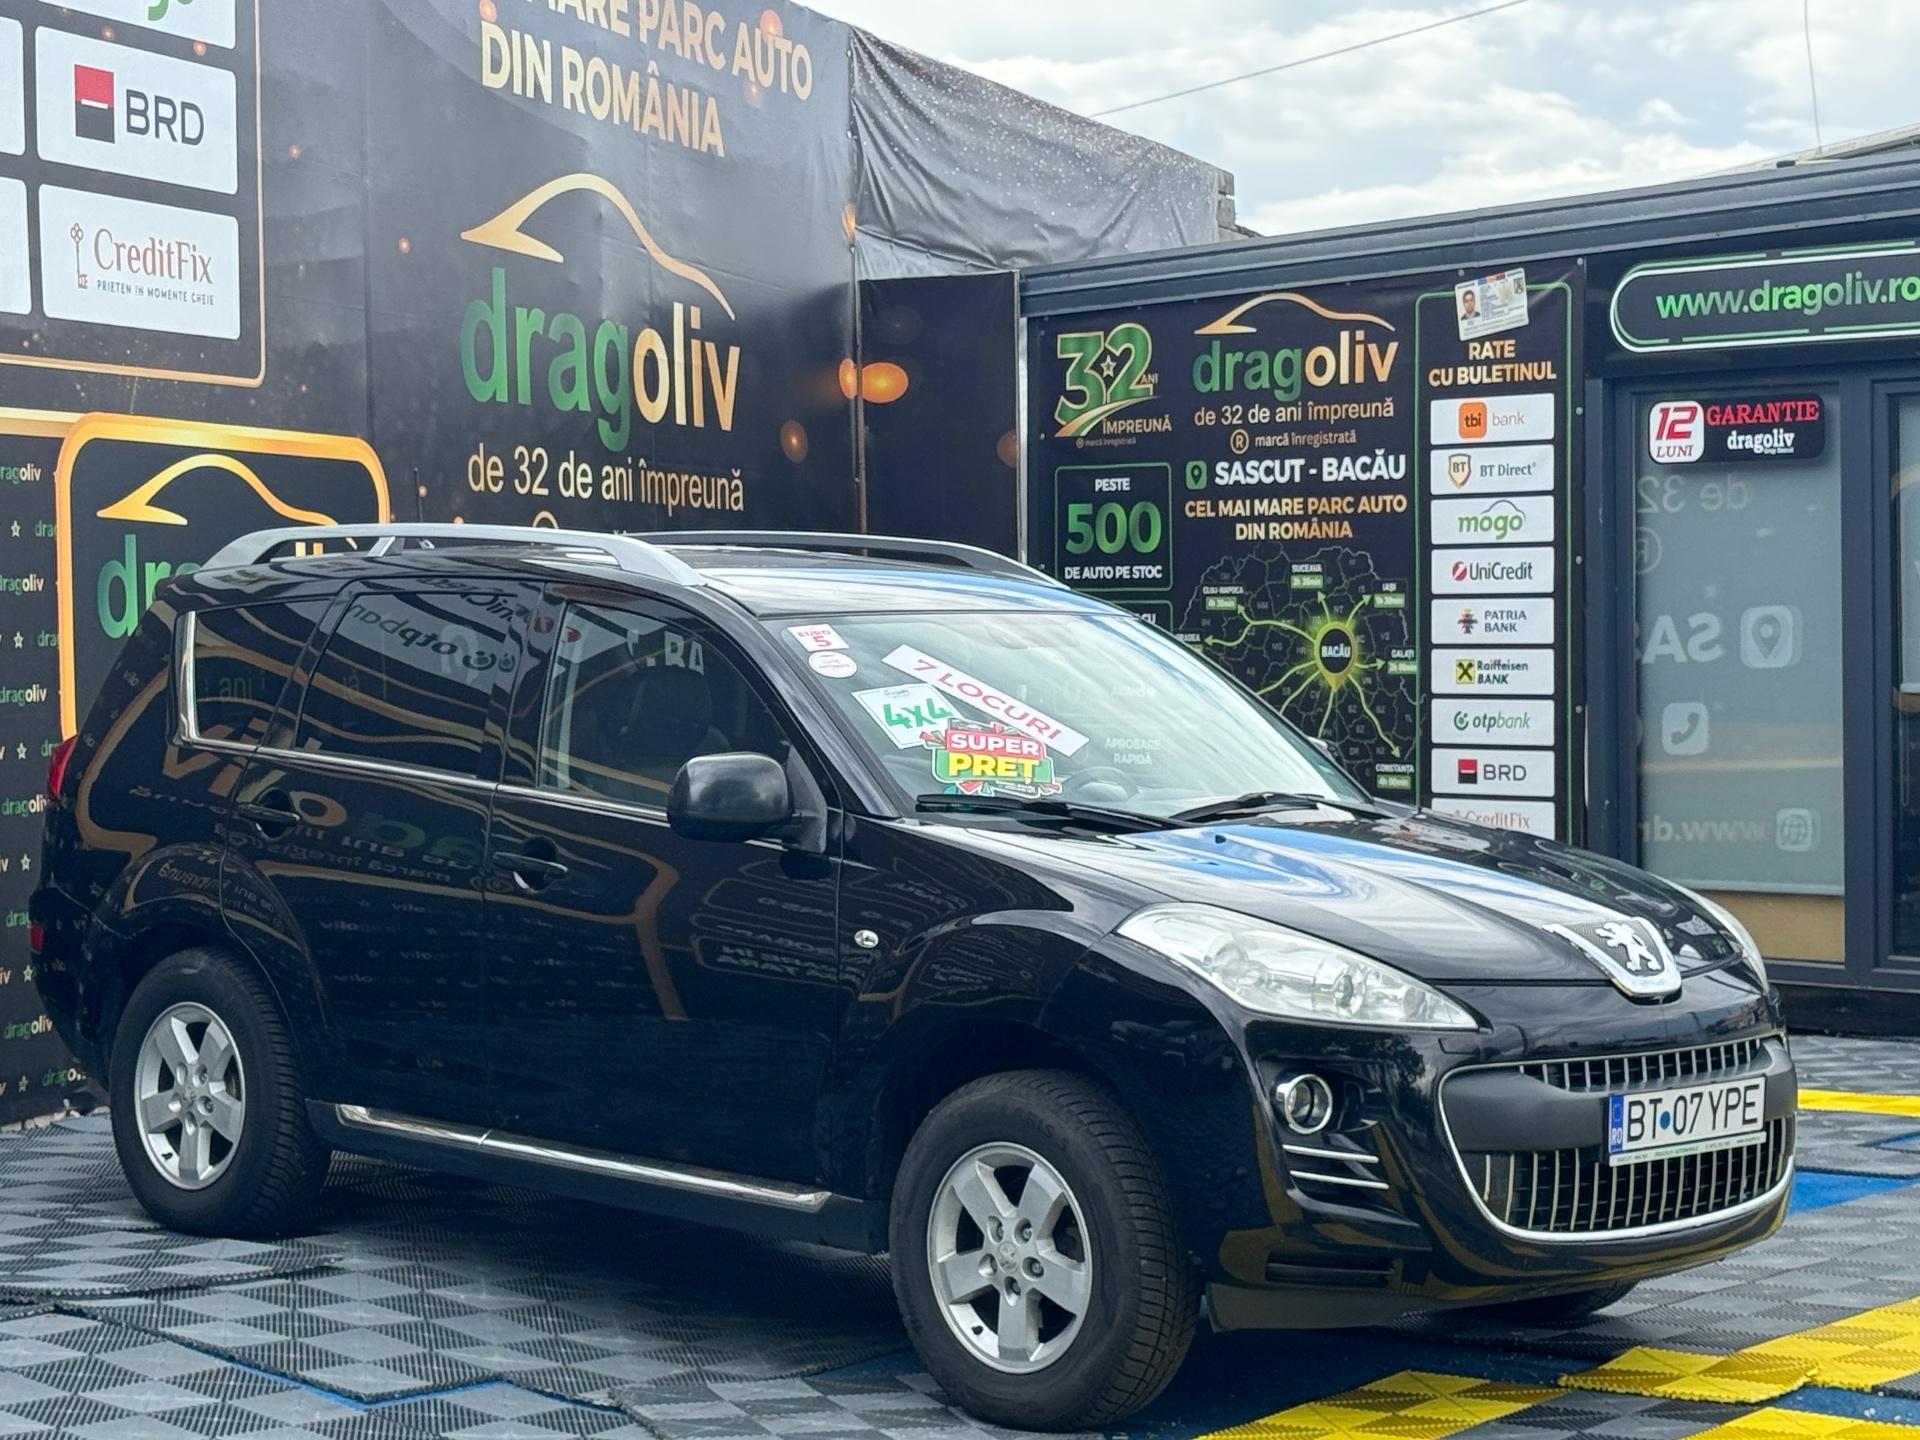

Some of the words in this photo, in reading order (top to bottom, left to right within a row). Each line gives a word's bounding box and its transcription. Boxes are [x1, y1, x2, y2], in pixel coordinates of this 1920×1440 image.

[548, 0, 631, 37] RE
[639, 0, 726, 70] PARC
[731, 21, 813, 100] AUTO
[481, 20, 552, 104] DIN
[562, 46, 725, 158] ROMÂNIA
[126, 89, 205, 146] BRD
[94, 228, 213, 285] CreditFix
[97, 279, 131, 295] PRIETEN
[147, 287, 188, 303] MOMENTE
[191, 292, 214, 306] CHEIE
[1656, 271, 1920, 319] www.dragoliv.ro
[461, 267, 740, 452] dragoliv
[1468, 340, 1516, 360] RATE
[1054, 323, 1152, 426] 32
[1193, 330, 1399, 401] dragoliv
[1428, 368, 1453, 387] CU
[1457, 361, 1556, 385] BULETINUL
[1140, 373, 1159, 385] ANI
[1194, 407, 1216, 426] de
[1221, 404, 1243, 425] 32
[1248, 404, 1270, 424] de
[1275, 402, 1302, 422] ani
[1307, 397, 1394, 424] împreună
[1464, 412, 1482, 428] tbi
[1492, 412, 1525, 427] bank
[1656, 406, 1698, 440] 12
[1706, 401, 1819, 426] GARANTIE
[1102, 414, 1172, 435] ÎMPREUNĂ
[1255, 432, 1289, 447] marcă
[1291, 429, 1356, 448] înregistrată
[1727, 428, 1795, 453] dragoliv
[1656, 445, 1694, 458] LUNI
[0, 463, 41, 484] ragoliv
[1215, 458, 1305, 485] SASCUT
[1322, 448, 1406, 483] BACĂU
[1452, 461, 1466, 474] BT
[1480, 465, 1495, 478] BT
[467, 443, 504, 493] de
[514, 445, 549, 495] 32
[558, 450, 593, 499] de
[601, 457, 633, 502] ani
[639, 458, 744, 517] împreună
[1094, 478, 1130, 492] PESTE
[1185, 500, 1215, 518] CEL
[1218, 499, 1250, 517] MAI
[1254, 497, 1304, 516] MARE
[1308, 496, 1354, 515] PARC
[1357, 494, 1408, 514] AUTO
[1065, 501, 1162, 554] 500
[1235, 523, 1266, 541] DIN
[1269, 518, 1353, 540] ROMÂNIA
[1458, 514, 1523, 540] mogo
[1064, 567, 1081, 580] DE
[1083, 567, 1114, 579] AUTO
[1115, 566, 1132, 579] PE
[1133, 565, 1162, 579] STOC
[1469, 562, 1533, 581] UniCredit
[1484, 610, 1527, 621] PATRIA
[1484, 622, 1517, 633] BANK
[813, 635, 832, 647] 5
[1321, 643, 1351, 658] BACĂU
[1477, 659, 1528, 672] Raiffeisen
[1477, 673, 1509, 685] BANK
[914, 659, 937, 671] 7
[938, 673, 1062, 740] LOCURI
[1472, 712, 1530, 733] otpbank
[951, 733, 1039, 756] SUPER
[949, 752, 1040, 785] PREȚ
[1483, 764, 1527, 781] BRD
[3, 1014, 53, 1039] dragoliv
[1627, 1098, 1663, 1142] BT
[1673, 1092, 1703, 1136] 07
[1709, 1083, 1760, 1130] YPE
[1611, 1129, 1623, 1145] RO
